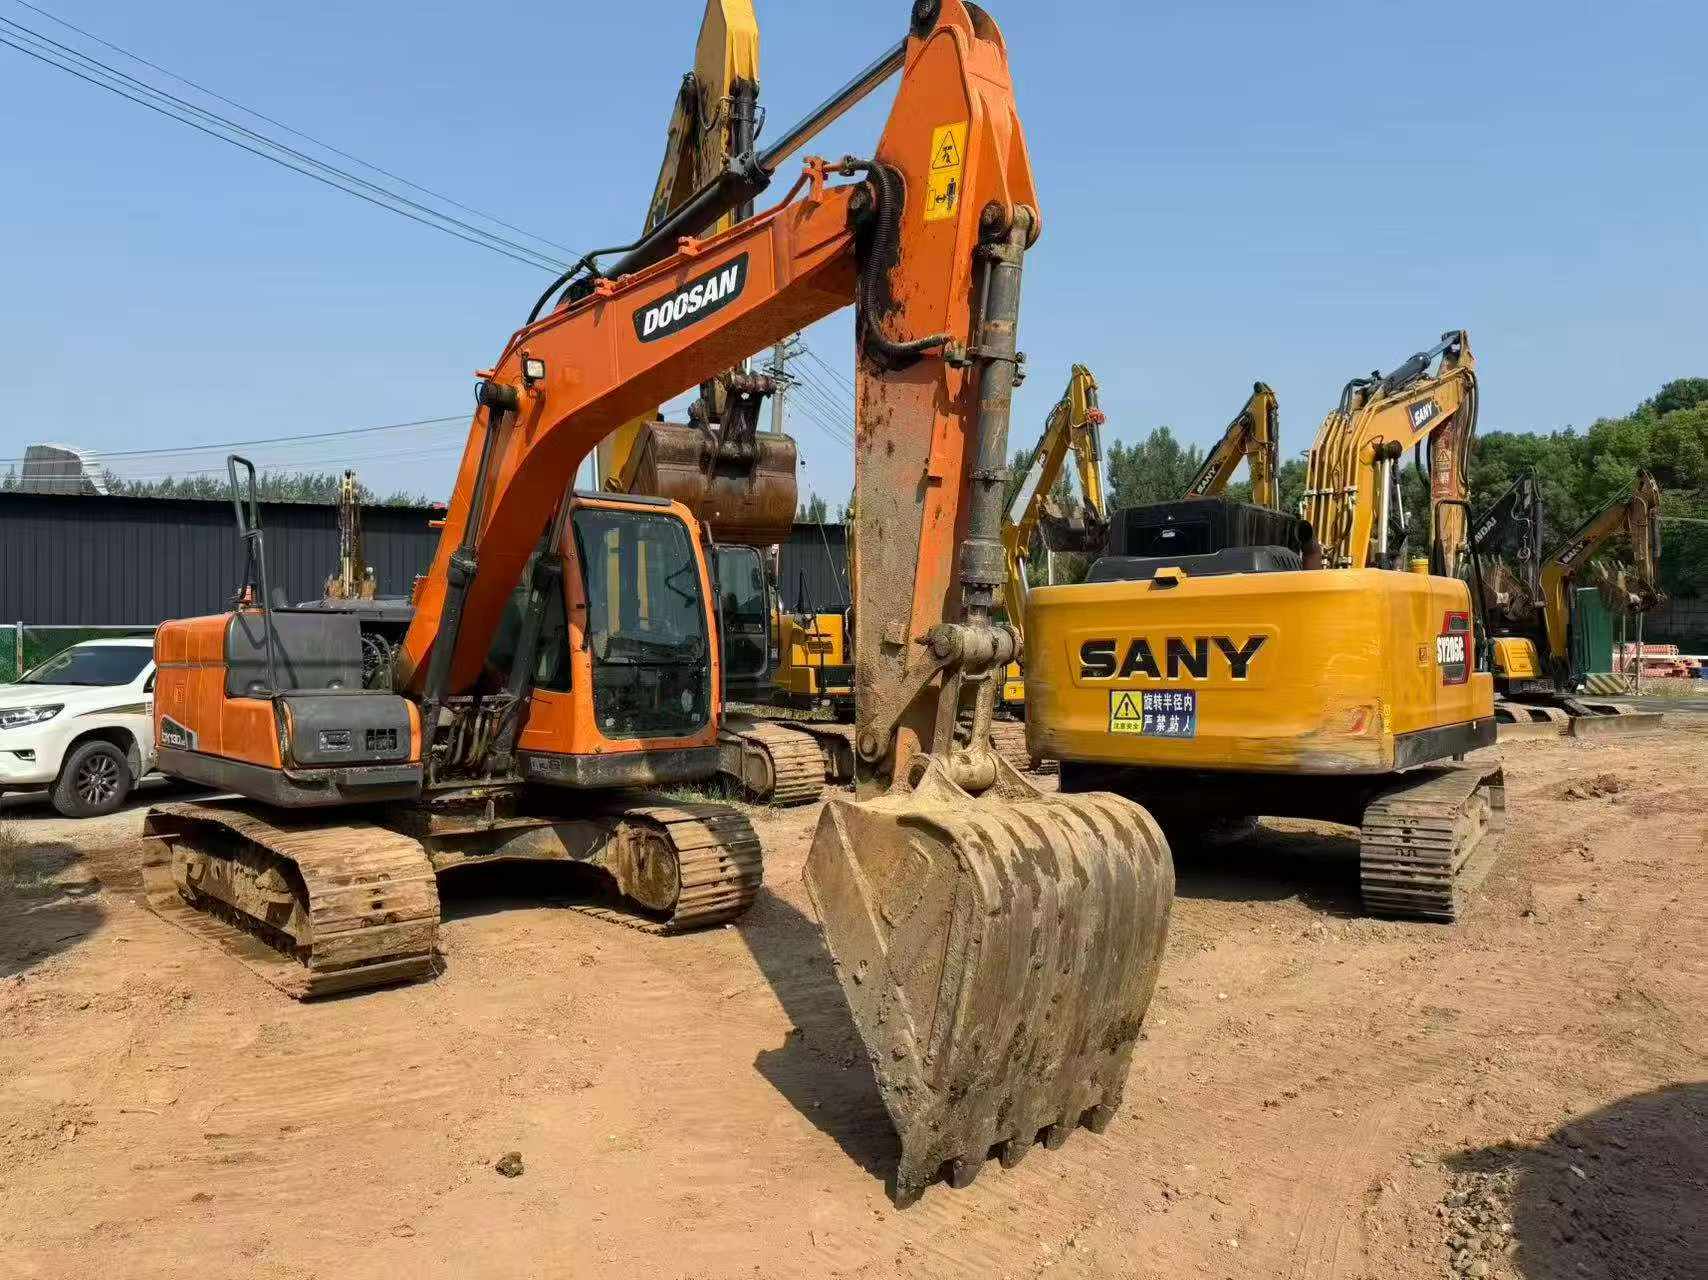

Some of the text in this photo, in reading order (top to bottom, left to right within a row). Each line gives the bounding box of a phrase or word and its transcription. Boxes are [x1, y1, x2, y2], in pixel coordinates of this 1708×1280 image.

[643, 264, 738, 336] DOOSAN
[1414, 401, 1433, 426] SANY
[1080, 635, 1268, 680] SANY
[1144, 693, 1192, 711] 旋转半径内
[1143, 714, 1191, 732] 严禁站人
